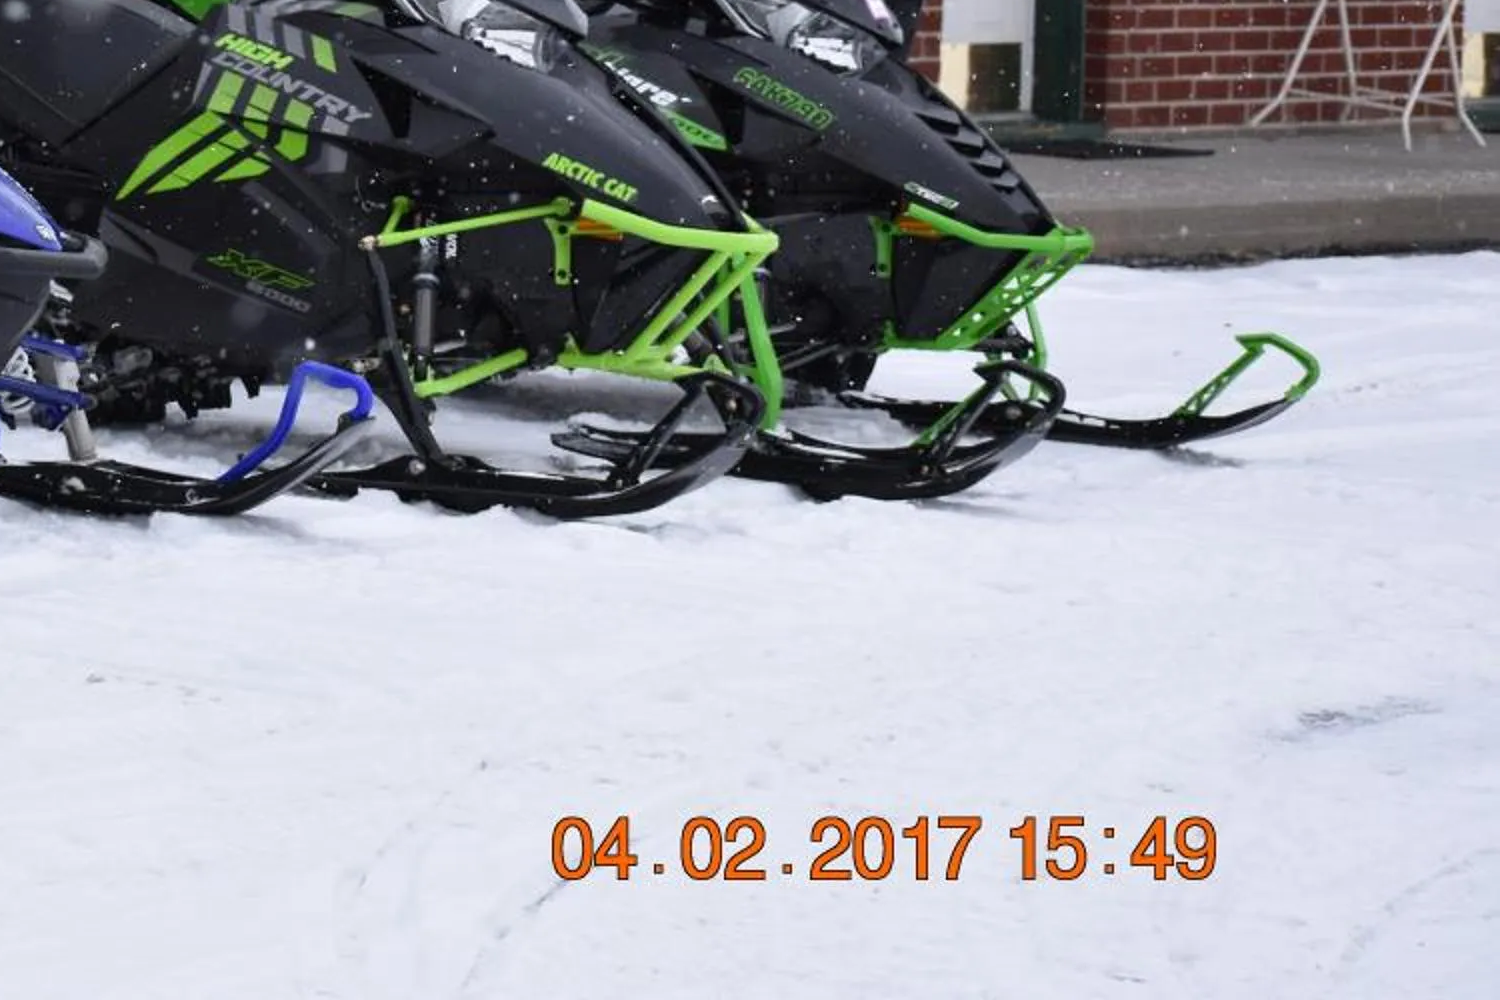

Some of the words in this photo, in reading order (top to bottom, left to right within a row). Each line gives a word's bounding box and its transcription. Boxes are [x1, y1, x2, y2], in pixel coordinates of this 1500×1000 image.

[214, 33, 295, 69] HIGH
[211, 51, 373, 123] COUNTRY
[542, 152, 605, 189] ARCTIC
[604, 178, 638, 202] CAT
